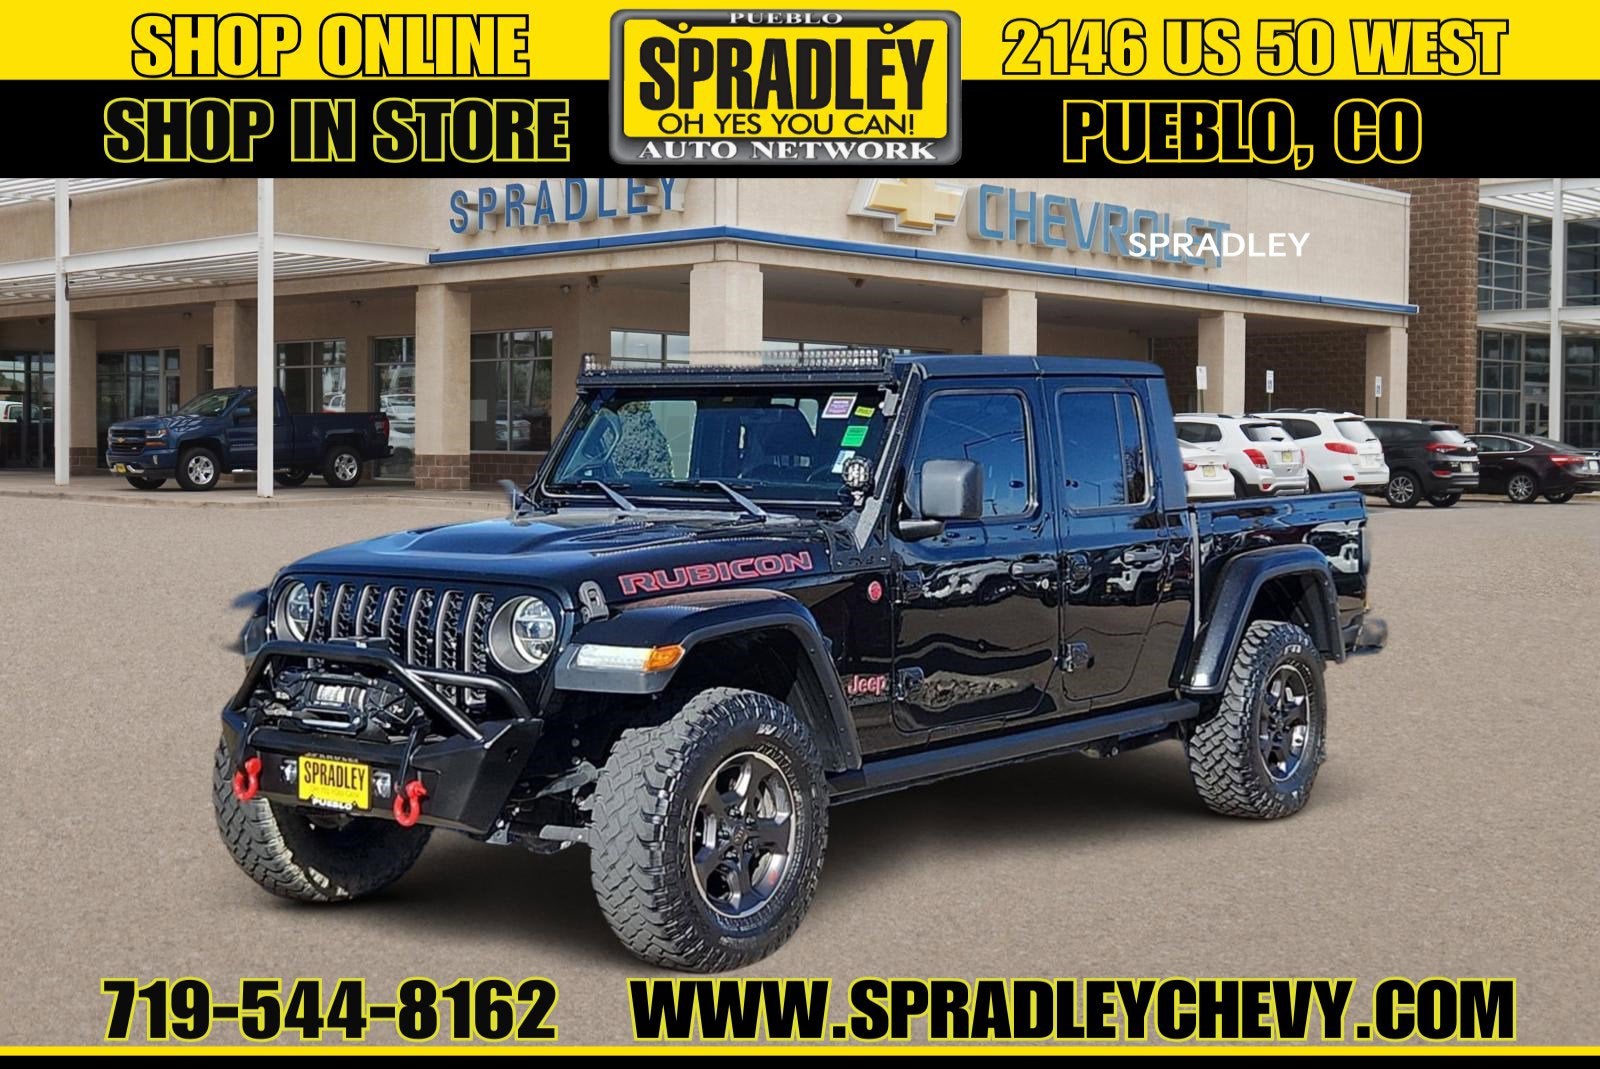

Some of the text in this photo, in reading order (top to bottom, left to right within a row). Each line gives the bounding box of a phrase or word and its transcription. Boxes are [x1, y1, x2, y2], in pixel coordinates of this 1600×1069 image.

[450, 178, 681, 235] SPRADLEY
[618, 551, 814, 596] RUBICON
[847, 674, 887, 696] Jeep
[304, 760, 366, 792] SPRADLEY
